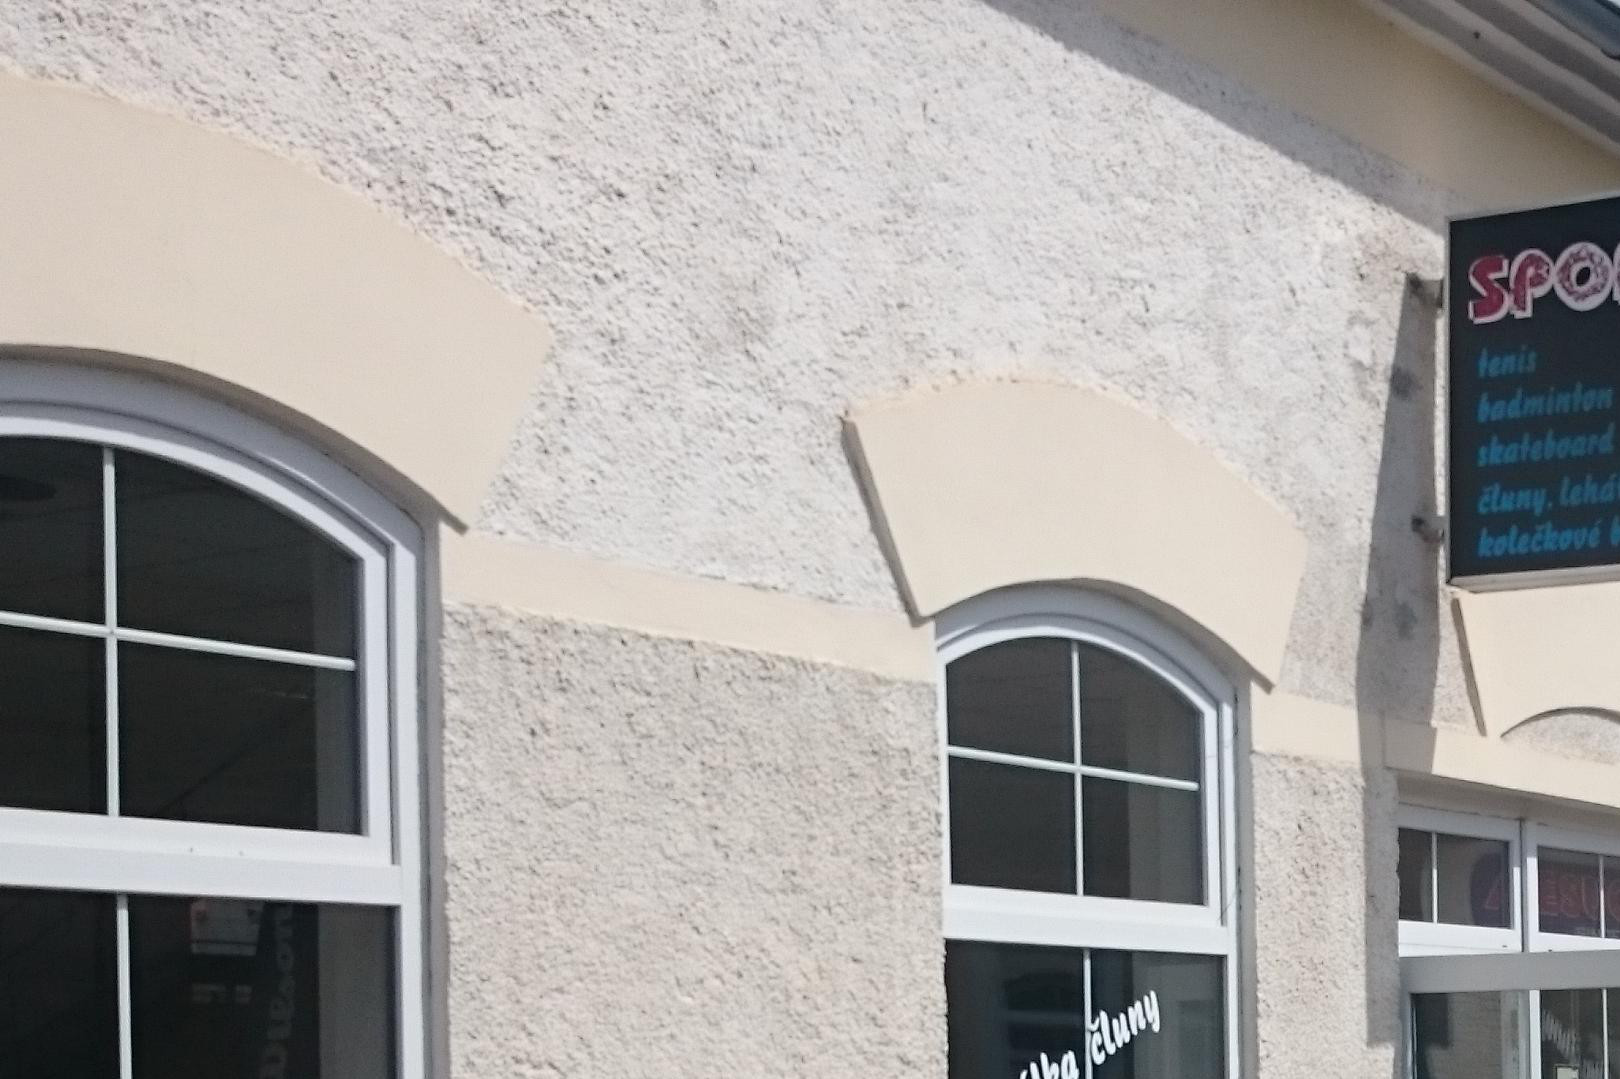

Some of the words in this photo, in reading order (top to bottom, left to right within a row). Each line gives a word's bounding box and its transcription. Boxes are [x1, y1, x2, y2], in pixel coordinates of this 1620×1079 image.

[1477, 345, 1537, 378] tenis
[1477, 381, 1615, 423] badminton
[1477, 422, 1616, 467] skateboard
[1477, 517, 1603, 557] kolečkové
[1089, 990, 1160, 1065] čluny
